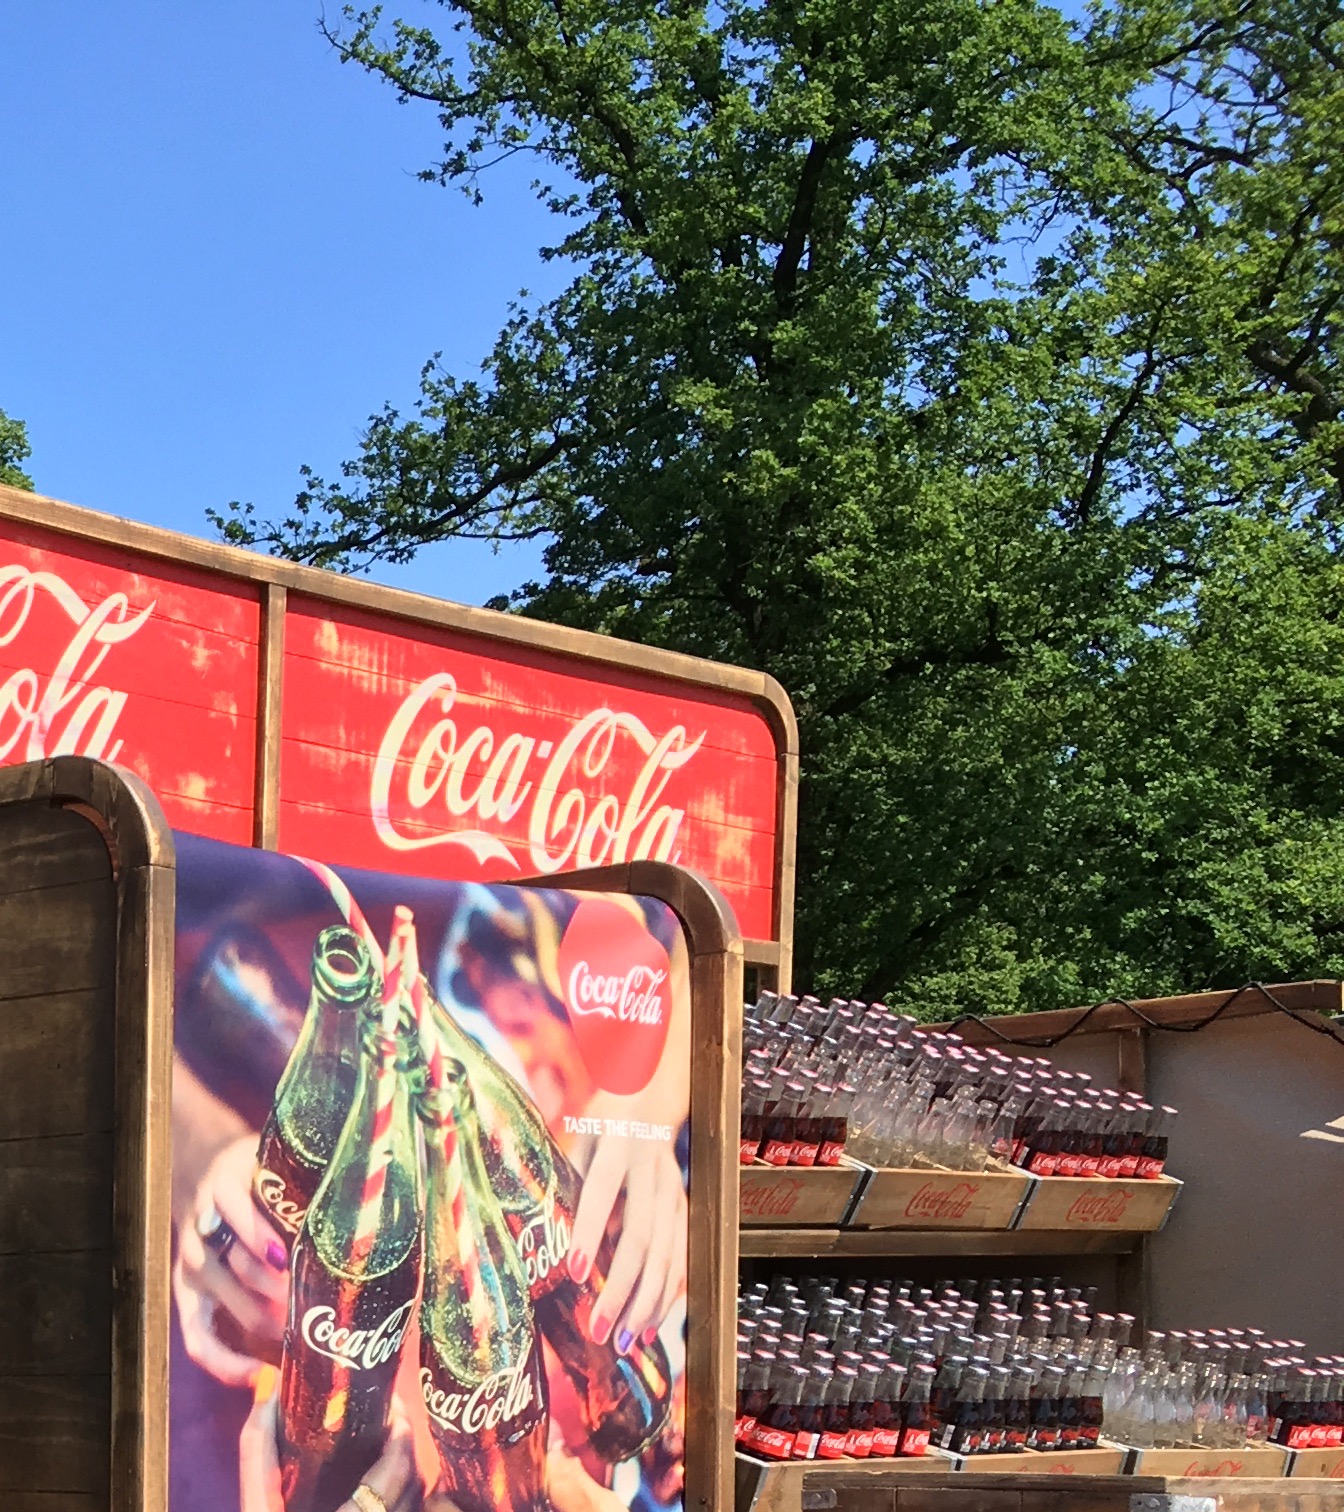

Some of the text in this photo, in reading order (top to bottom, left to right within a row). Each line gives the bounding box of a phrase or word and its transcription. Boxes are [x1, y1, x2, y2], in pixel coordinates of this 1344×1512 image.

[370, 672, 706, 875] Coca-Cola
[569, 961, 667, 1024] Coca-Cola
[564, 1116, 672, 1141] TASTE THE FEELING
